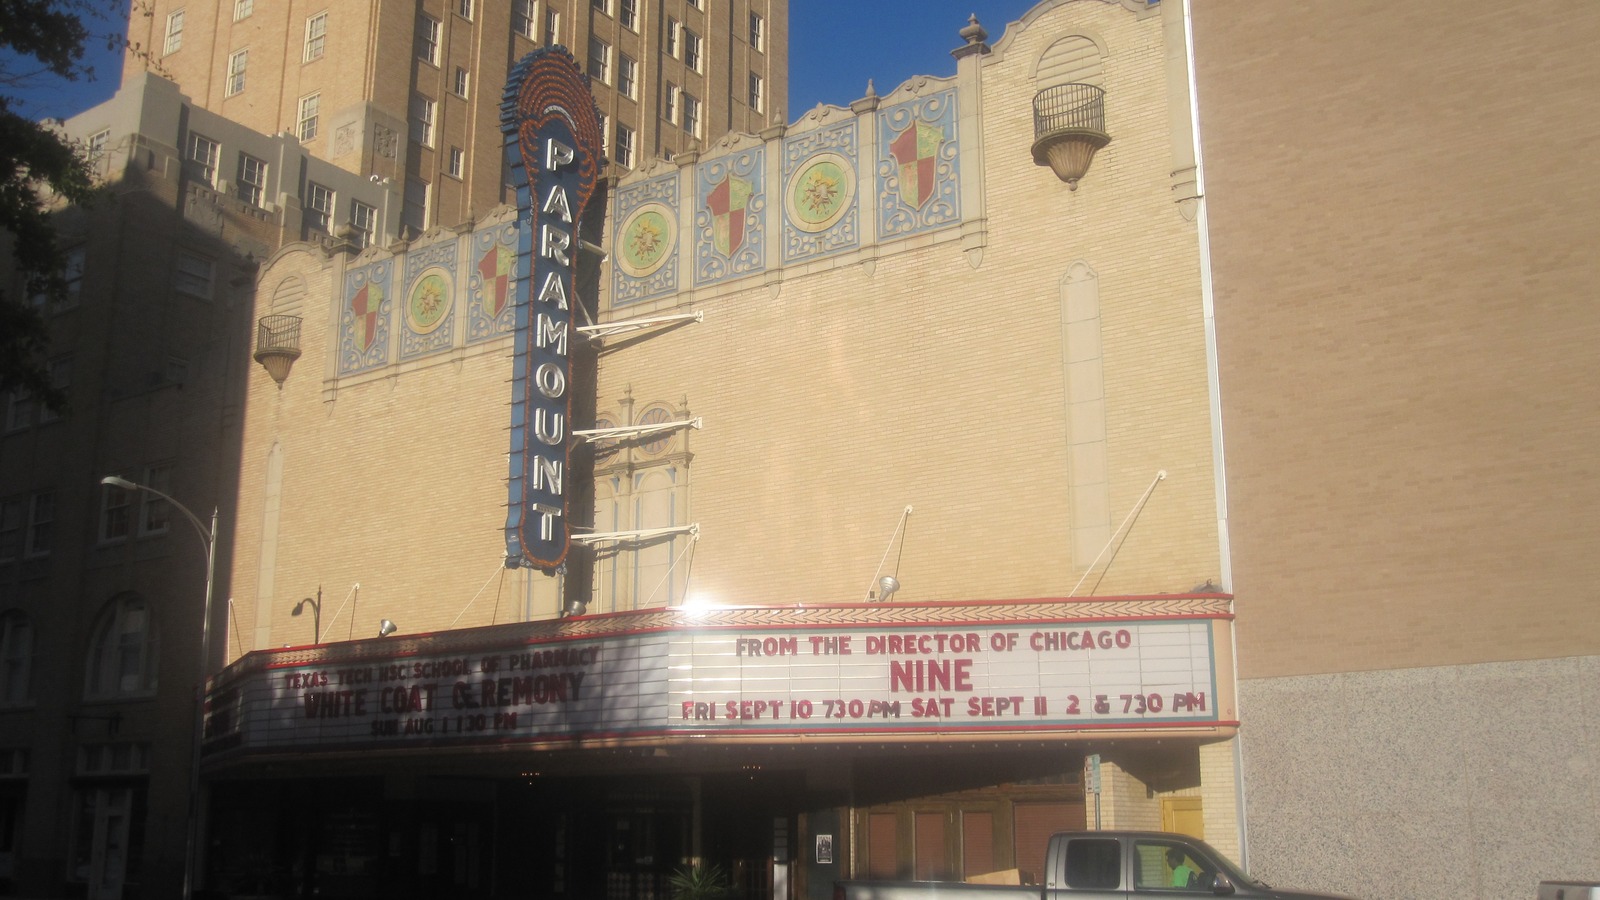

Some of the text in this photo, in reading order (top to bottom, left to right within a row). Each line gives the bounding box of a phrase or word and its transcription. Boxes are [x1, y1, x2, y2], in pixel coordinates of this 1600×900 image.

[533, 138, 574, 542] PARAMOUNT
[736, 629, 1132, 658] FROM THE DIRECTOR OF CHICAGO
[284, 670, 328, 689] TEXAS
[337, 667, 372, 685] TECH
[414, 657, 471, 679] SCHOOL
[481, 655, 501, 673] OF
[509, 646, 600, 671] PHARMACY
[889, 658, 974, 693] NINE
[304, 688, 368, 719] WHITE
[381, 683, 438, 714] COAT
[682, 699, 716, 721] FRI
[725, 699, 784, 721] SEPT
[790, 699, 813, 720] 10
[911, 697, 954, 719] SAT
[967, 696, 1025, 718] SEPT
[1066, 696, 1081, 716] 2
[1093, 695, 1111, 715] &
[1119, 694, 1164, 715] 730
[1172, 691, 1206, 713] PM
[371, 719, 398, 736] SUN
[404, 718, 434, 735] AUG
[494, 712, 518, 730] PM
